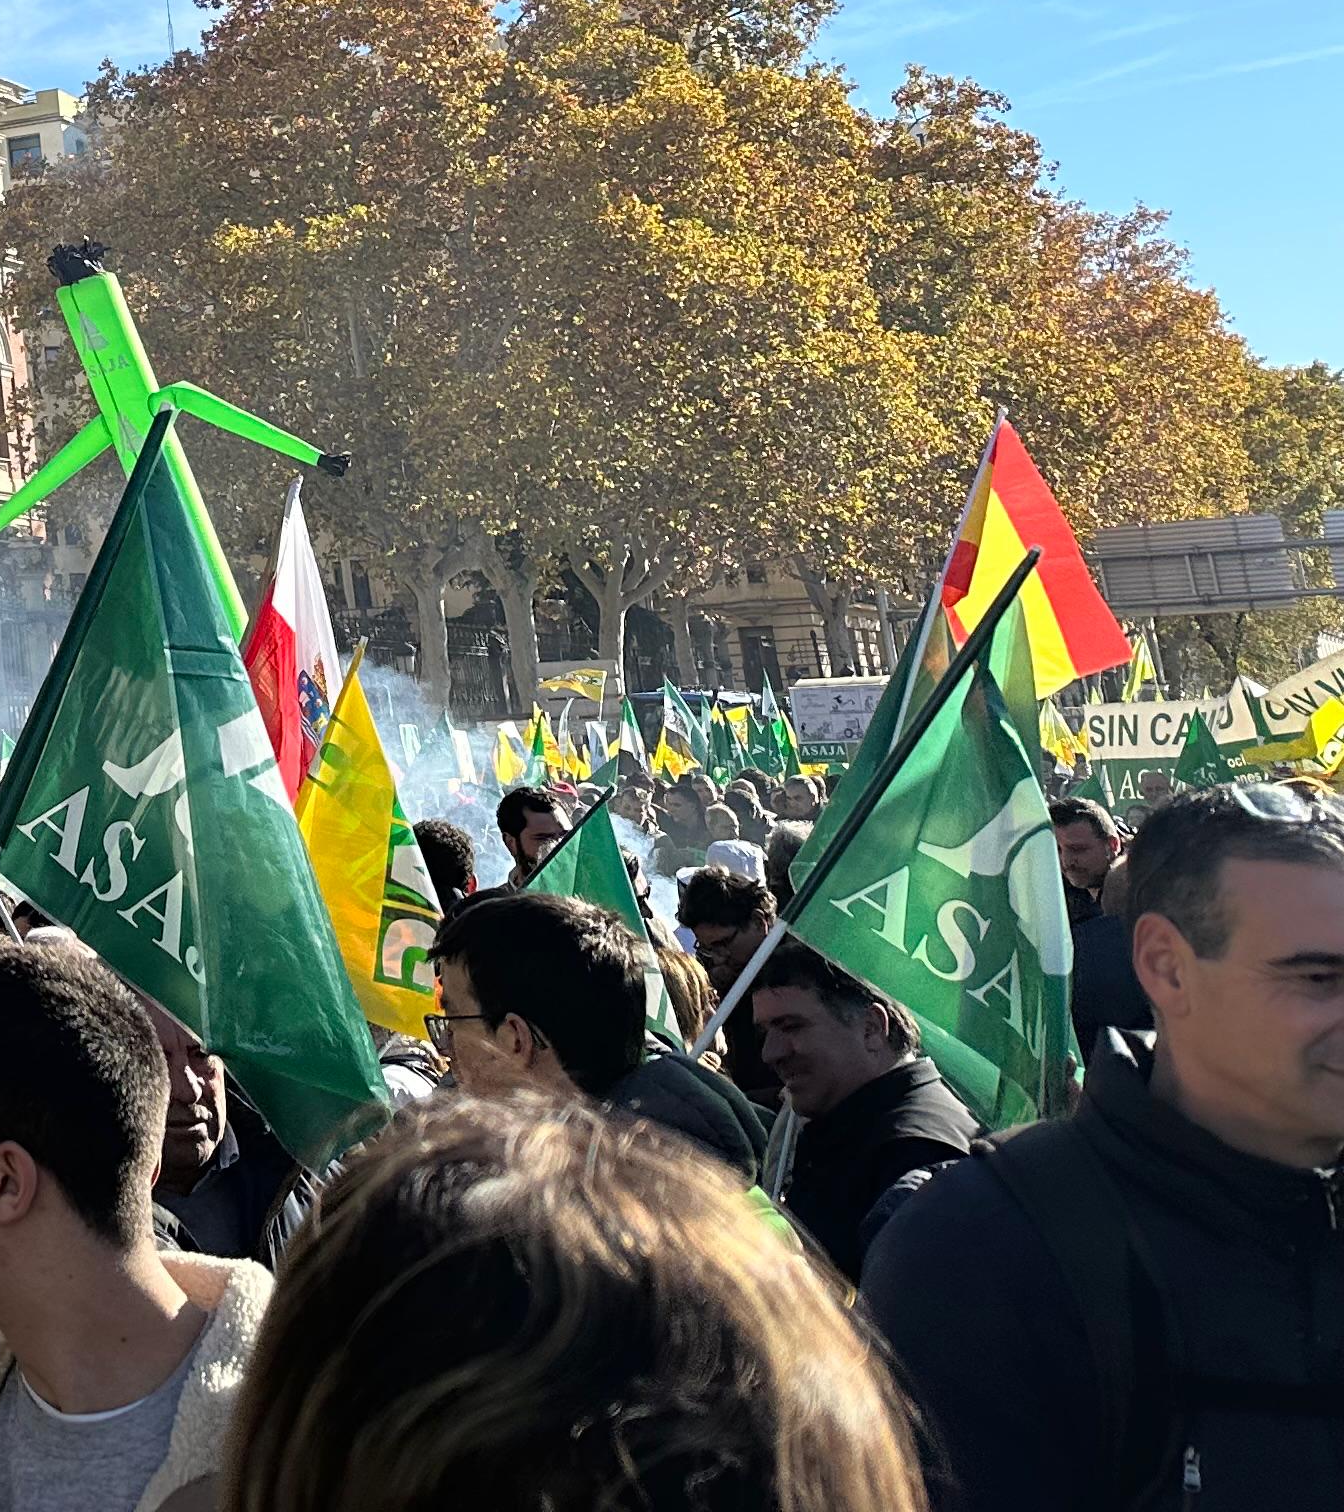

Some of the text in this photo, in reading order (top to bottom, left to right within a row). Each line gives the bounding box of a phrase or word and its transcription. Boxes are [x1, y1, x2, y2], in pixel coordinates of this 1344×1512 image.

[1089, 712, 1139, 747] SIN
[801, 745, 845, 756] ASAJA
[829, 865, 1044, 1060] ASAJ
